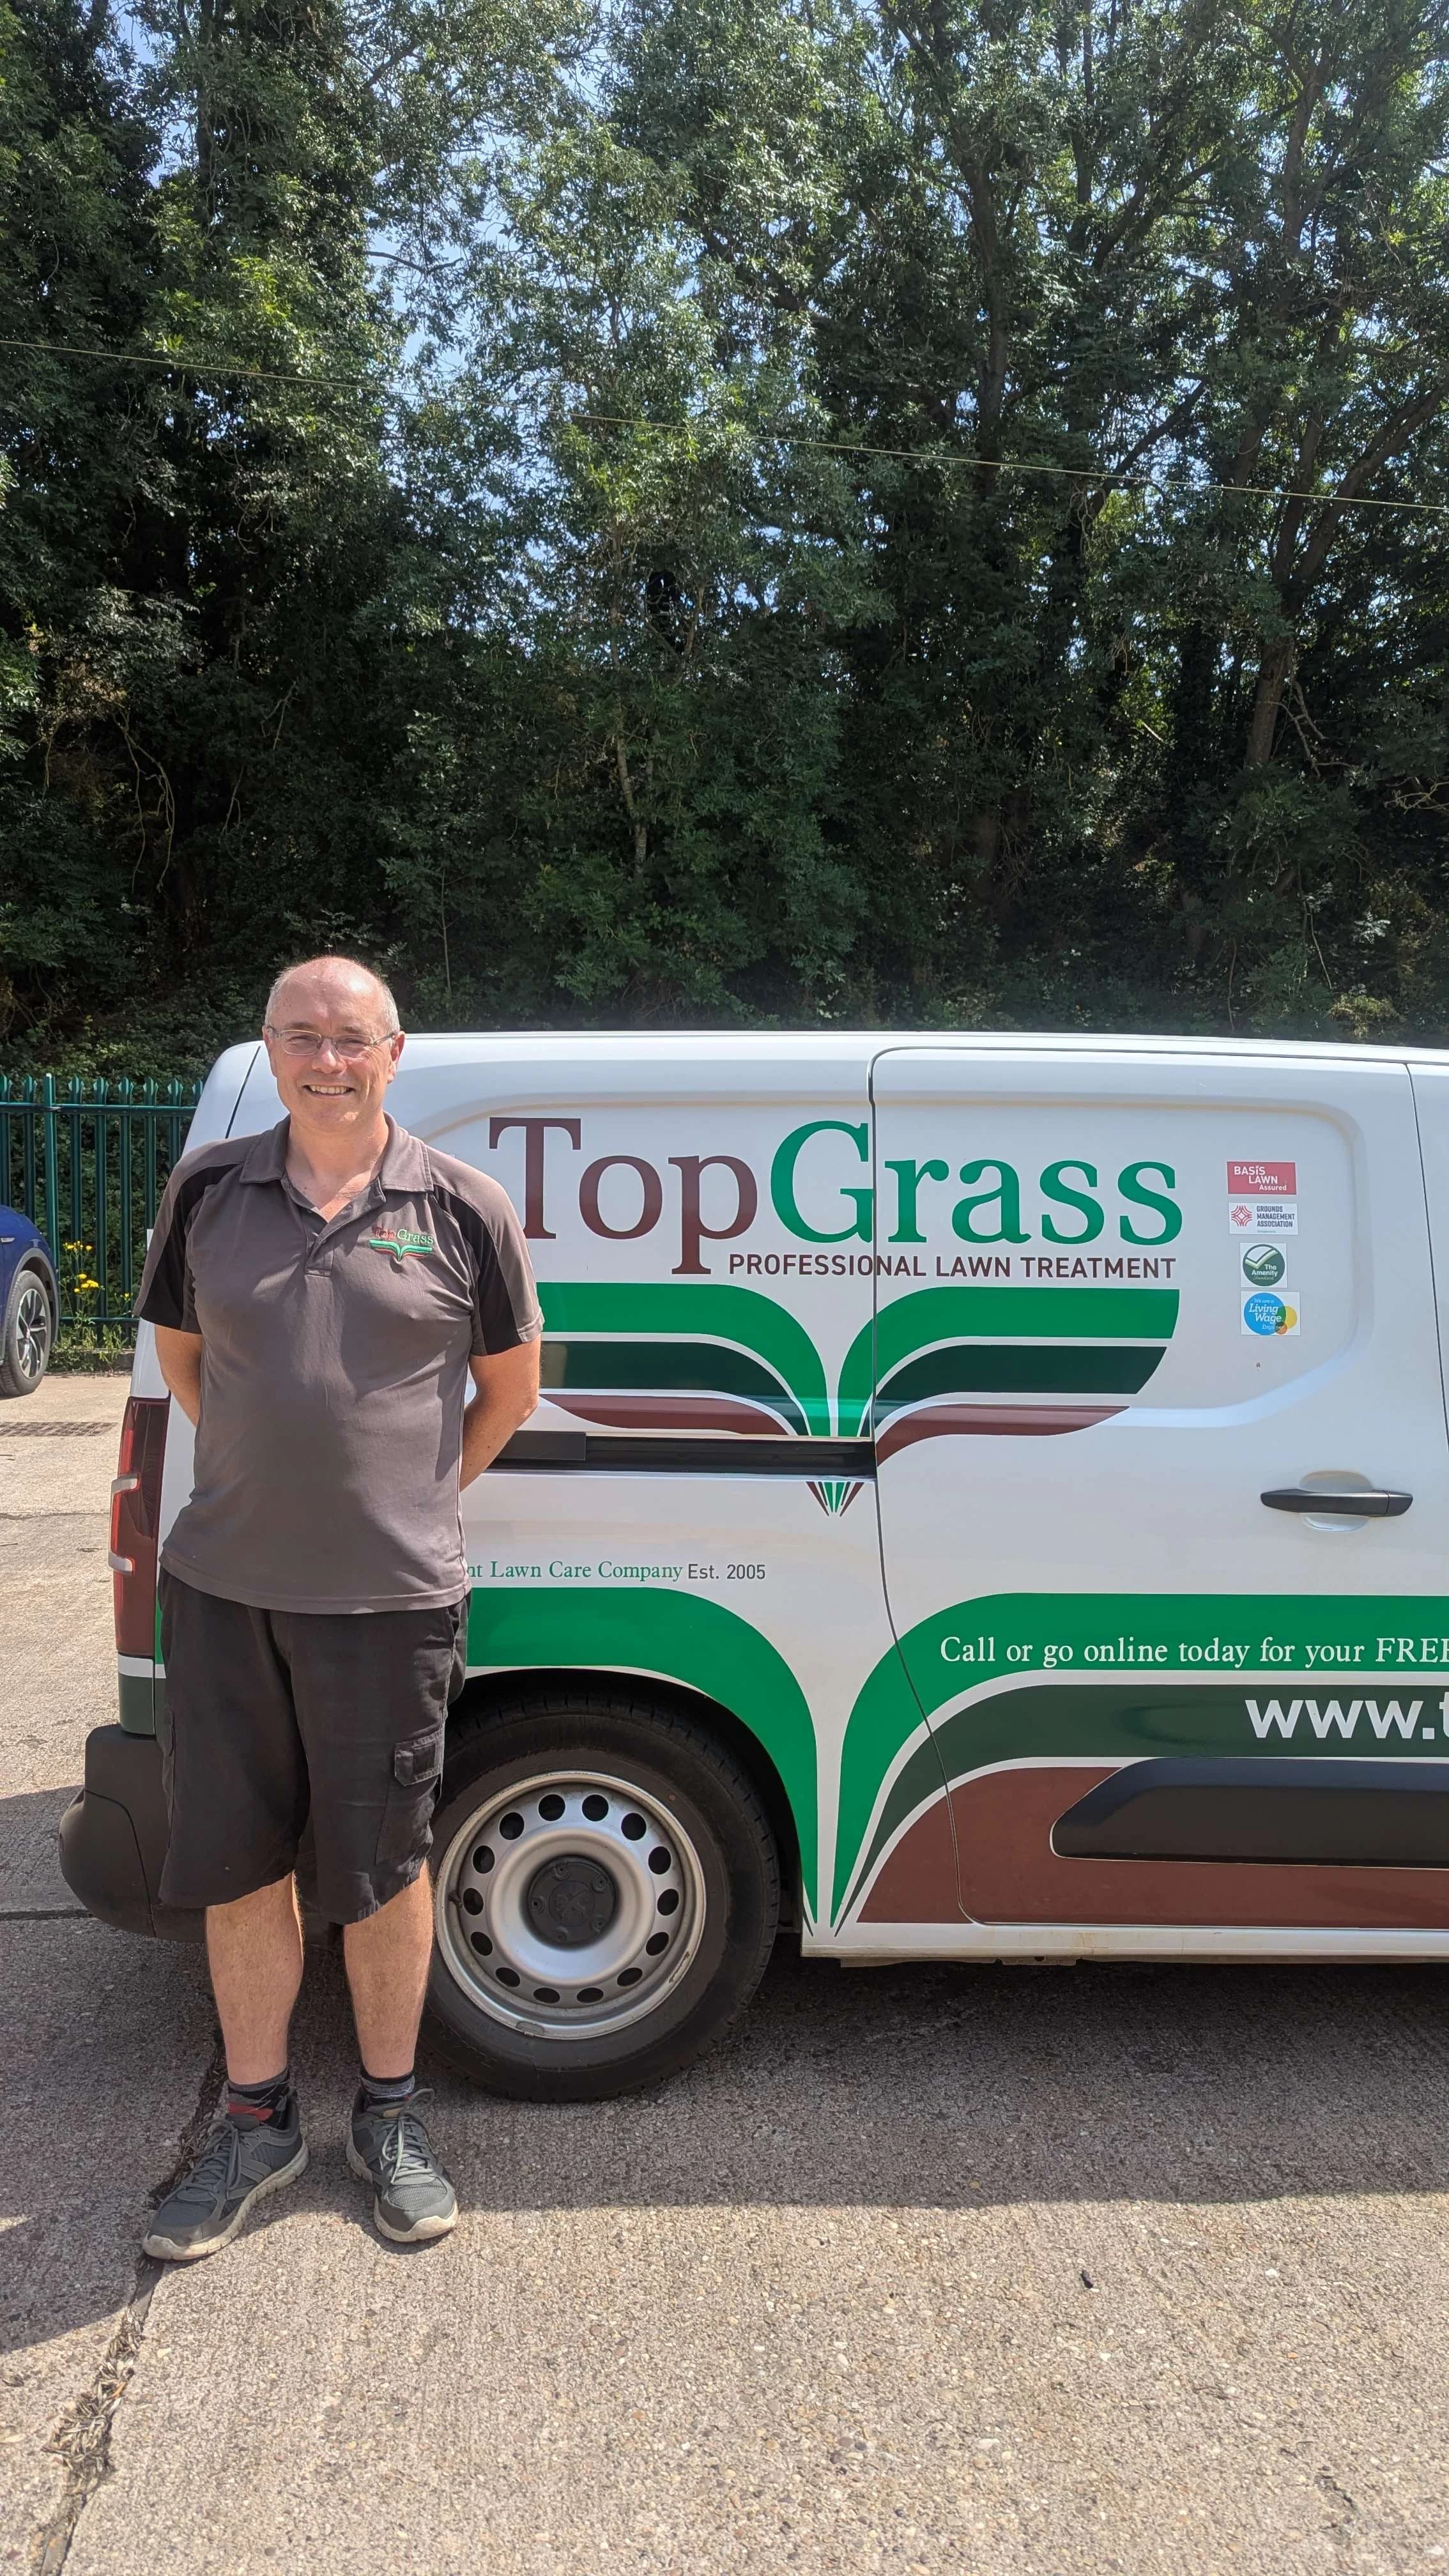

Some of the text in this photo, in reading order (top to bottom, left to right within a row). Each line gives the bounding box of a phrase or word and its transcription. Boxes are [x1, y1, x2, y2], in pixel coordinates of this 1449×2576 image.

[1248, 1175, 1278, 1184] LAWN
[489, 1117, 1183, 1275] TopGrass
[729, 1254, 1176, 1278] PROFESSIONAL LAWN TREATMENT
[1248, 1303, 1278, 1315] Living
[1255, 1312, 1282, 1324] Wage
[490, 1561, 542, 1578] Lawn
[549, 1560, 592, 1578] Care
[598, 1561, 684, 1582] Company
[688, 1563, 719, 1579] Est.
[727, 1564, 765, 1579] 2005
[940, 1636, 995, 1662] Call
[1006, 1644, 1033, 1662] or
[1043, 1644, 1073, 1668] go
[1084, 1637, 1168, 1662] online
[1178, 1637, 1250, 1668] today
[1259, 1636, 1295, 1662] for
[1305, 1644, 1365, 1669] your
